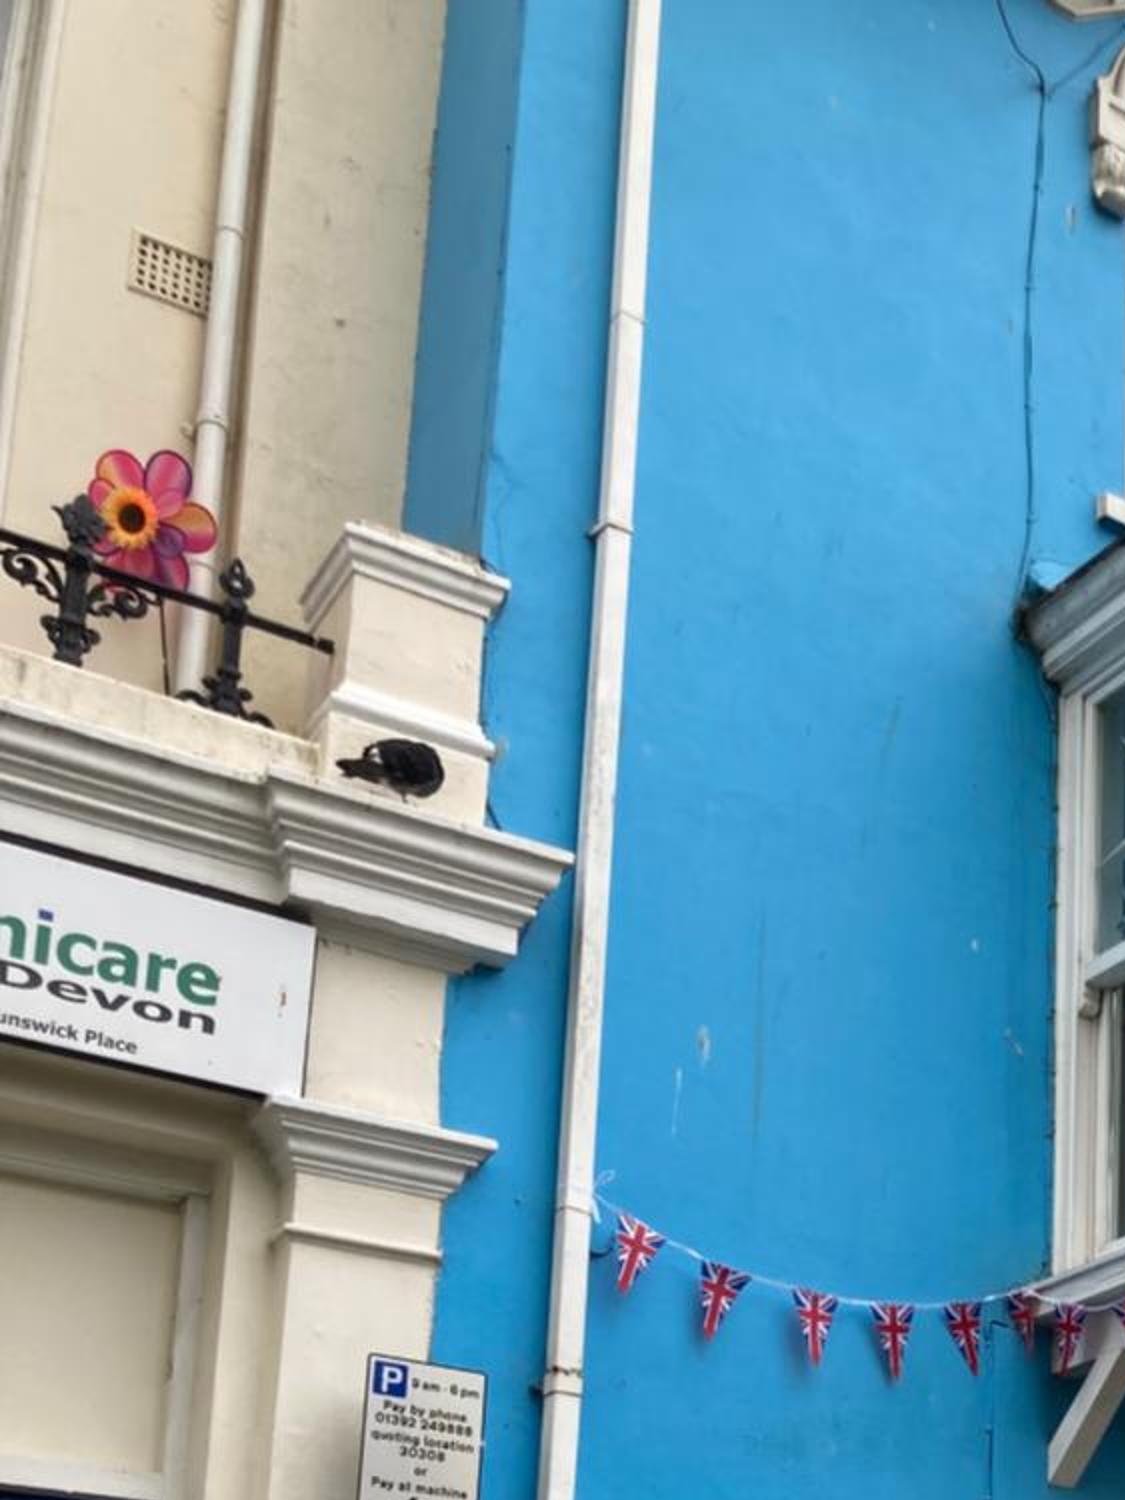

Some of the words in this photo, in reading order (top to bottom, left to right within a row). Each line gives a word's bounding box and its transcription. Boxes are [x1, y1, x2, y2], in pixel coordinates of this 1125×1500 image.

[0, 959, 217, 1035] Devon
[84, 1028, 138, 1054] Place
[381, 1366, 403, 1393] P
[422, 1381, 441, 1392] am
[460, 1388, 480, 1399] pm
[375, 1411, 417, 1428] 01392
[383, 1400, 406, 1414] Pay
[409, 1405, 426, 1418] by
[429, 1408, 467, 1423] phone
[423, 1436, 475, 1454] location
[413, 1467, 428, 1477] or
[371, 1475, 395, 1491] Pay
[398, 1480, 412, 1492] at
[415, 1484, 468, 1500] machine
